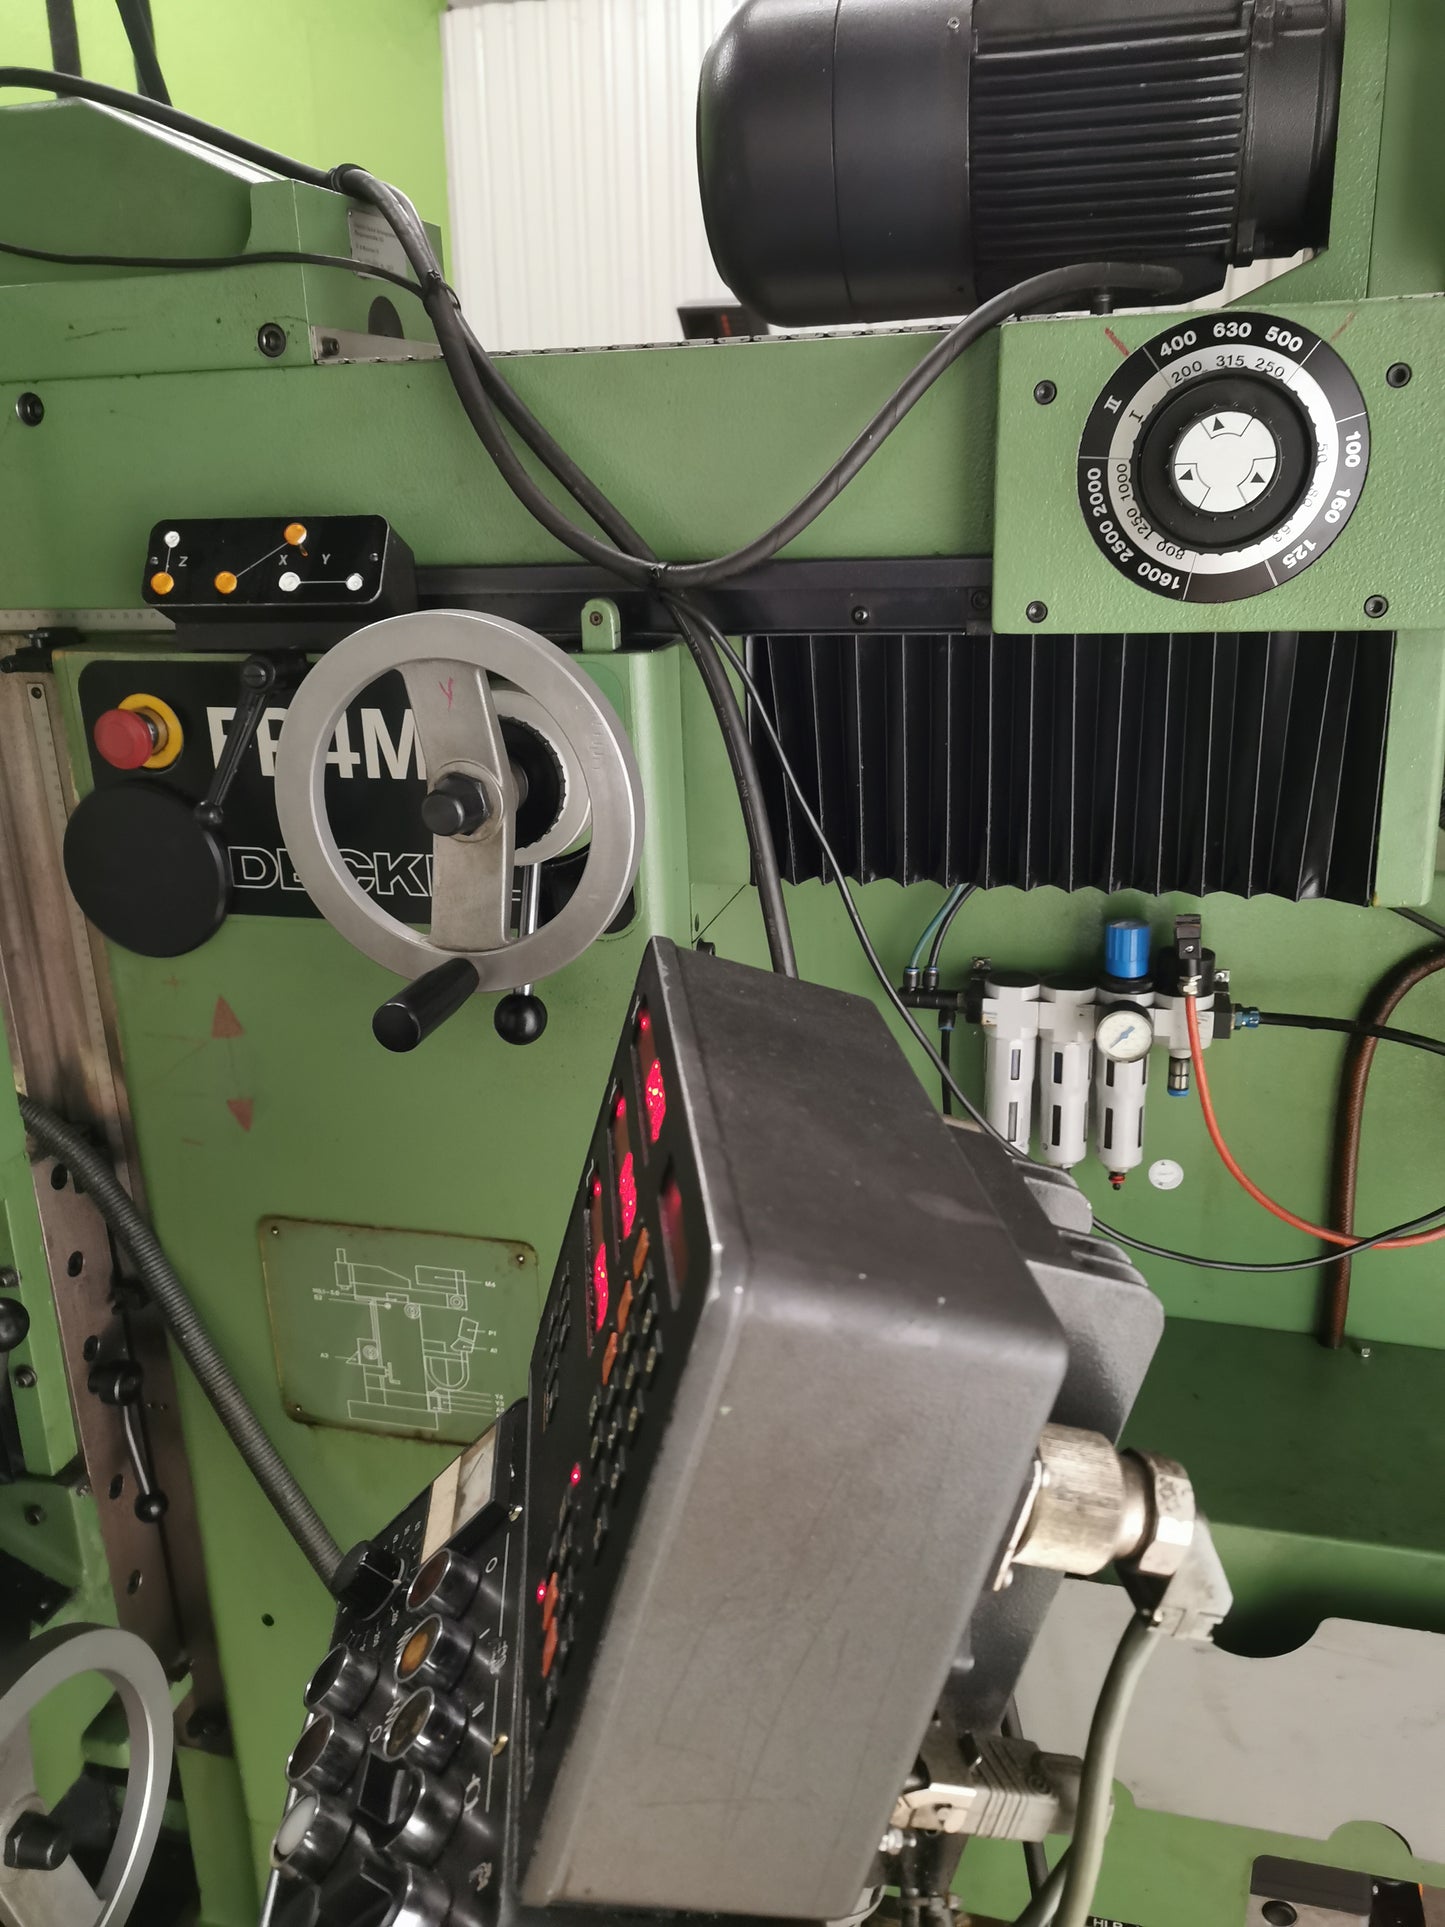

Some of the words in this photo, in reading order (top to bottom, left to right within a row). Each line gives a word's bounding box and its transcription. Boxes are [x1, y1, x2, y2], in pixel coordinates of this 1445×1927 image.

[1159, 329, 1198, 358] 400
[1212, 321, 1253, 339] 630
[1264, 325, 1304, 352] 500
[1171, 360, 1203, 385] 200
[1215, 355, 1245, 368] 315
[1254, 357, 1286, 379] 250
[1344, 430, 1362, 468] 100
[1116, 463, 1131, 502] 1000
[1126, 507, 1152, 541] 1250
[1156, 540, 1185, 561] 800
[1324, 488, 1352, 524] 160
[1086, 467, 1108, 518] 2000
[1099, 520, 1135, 563] 2500
[1137, 562, 1181, 590] 1600
[178, 555, 189, 568] Z
[278, 553, 289, 567] X
[321, 552, 332, 566] Y
[1282, 539, 1317, 569] 125
